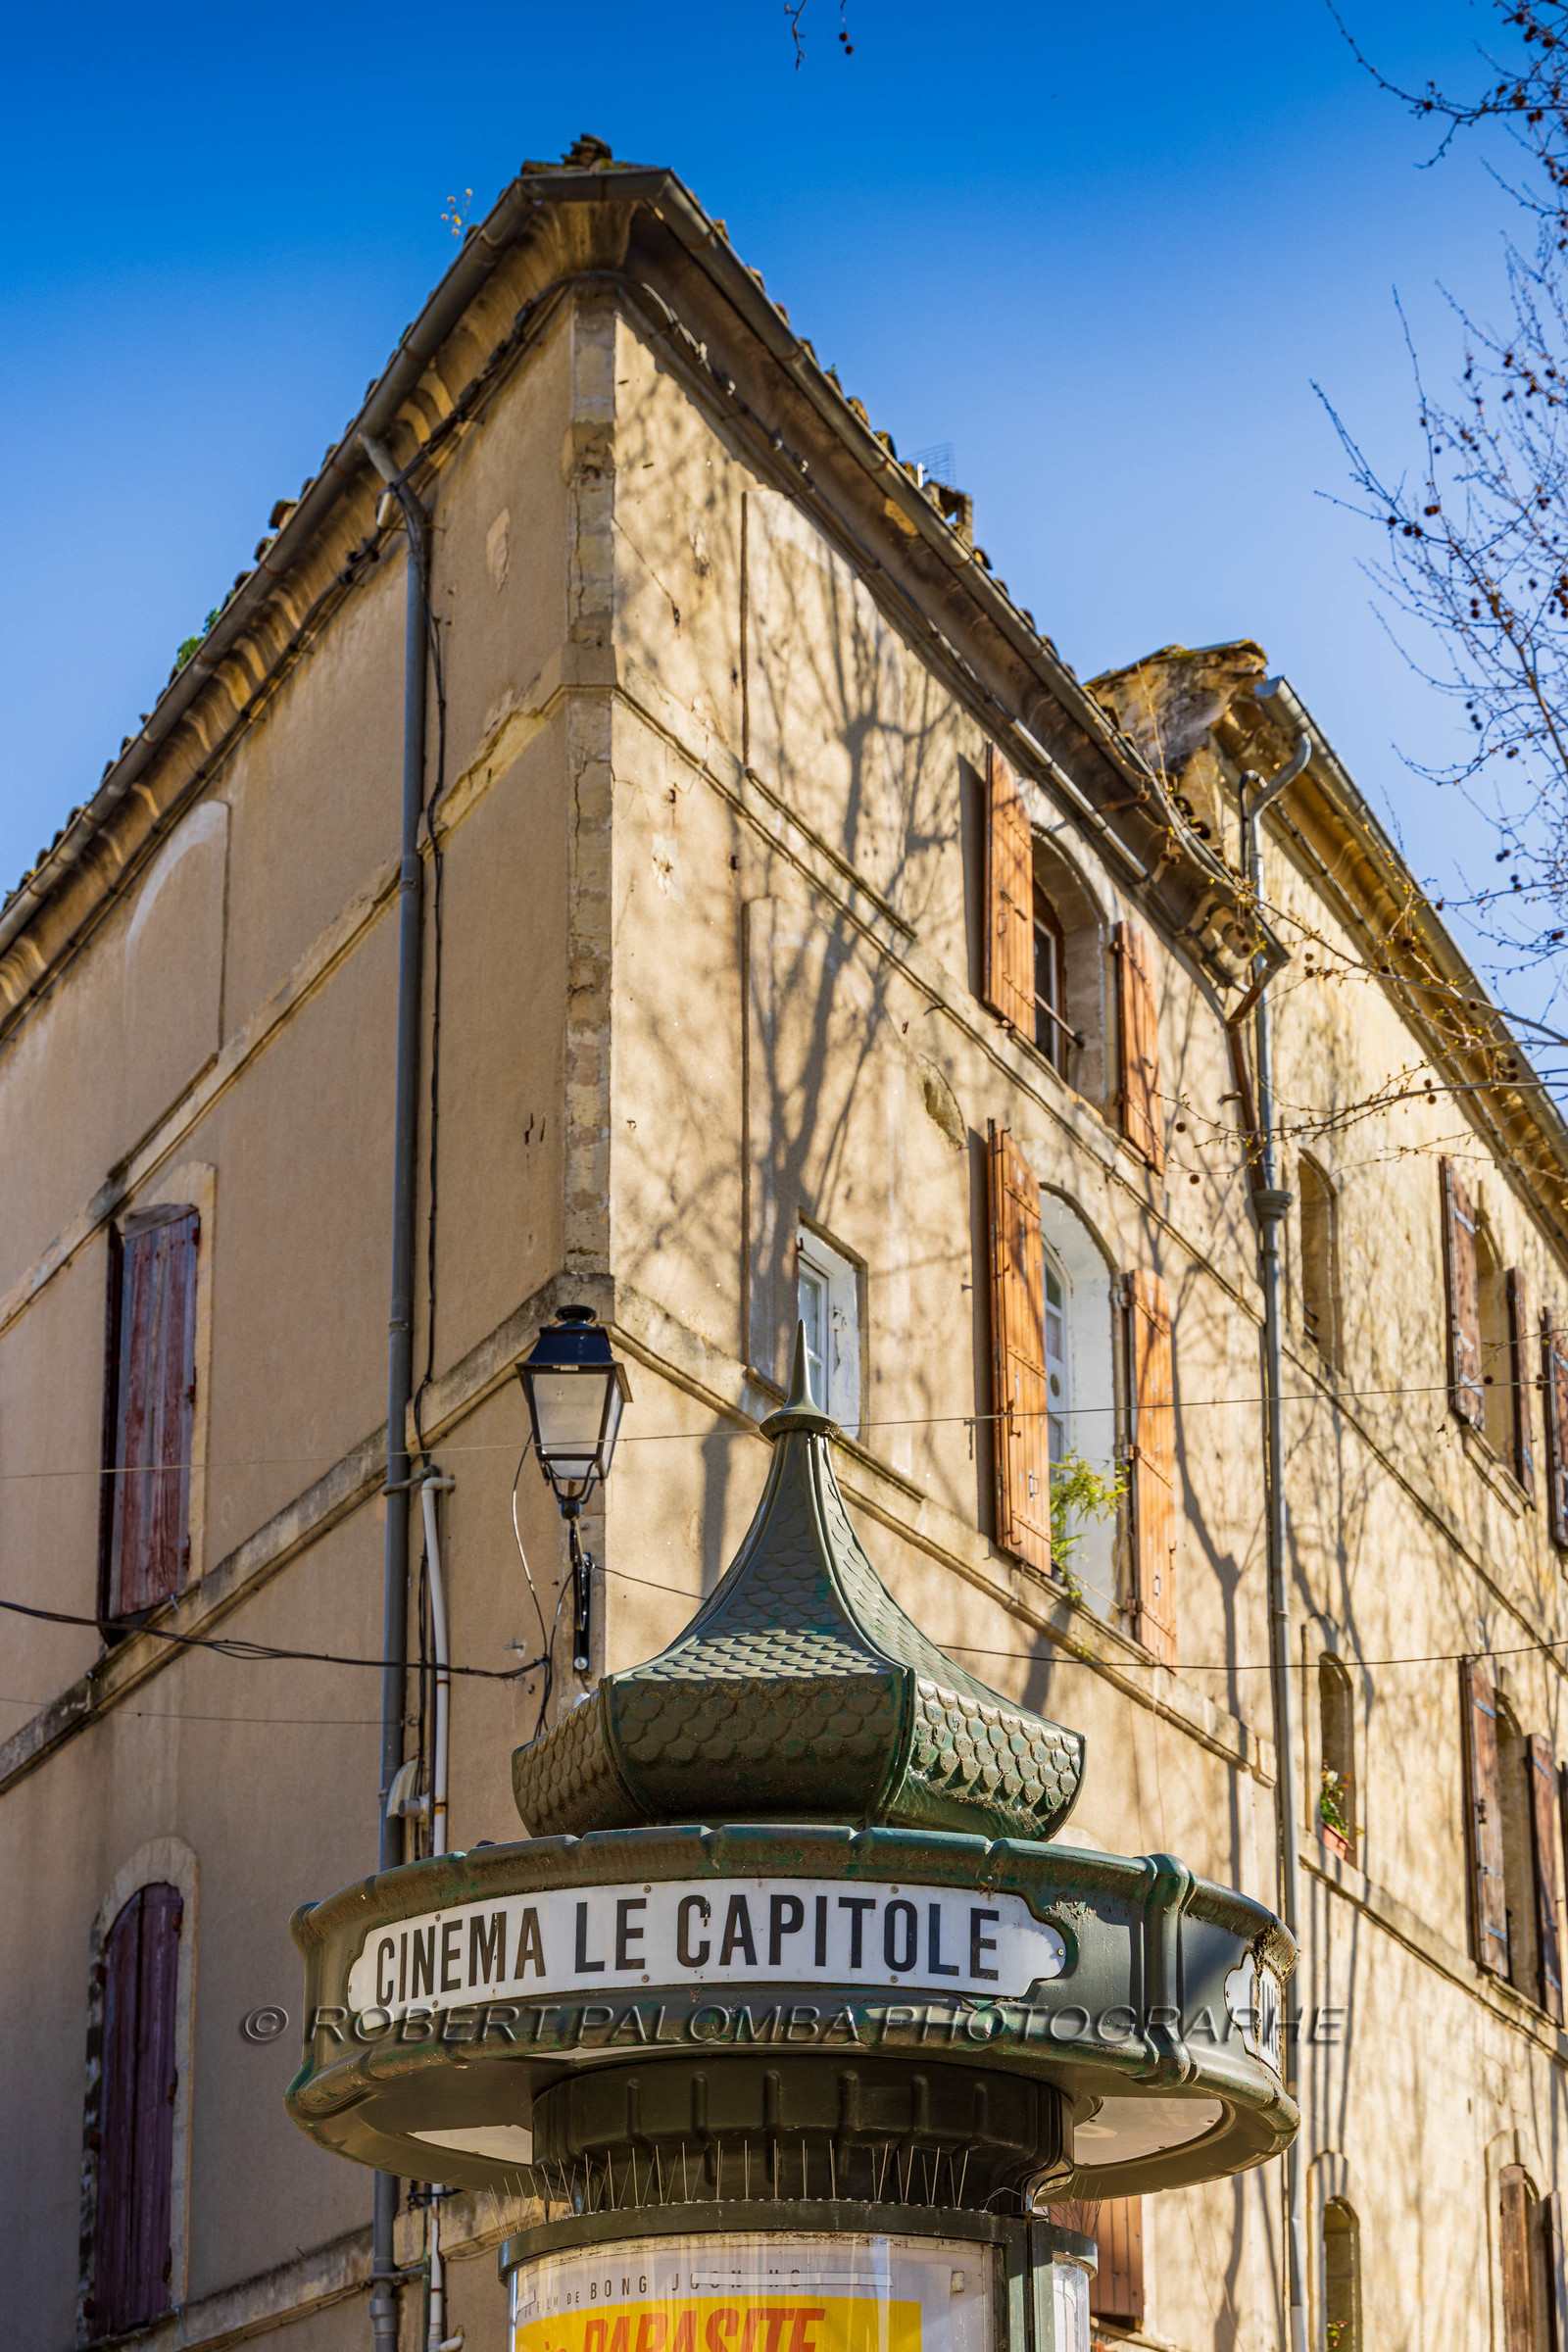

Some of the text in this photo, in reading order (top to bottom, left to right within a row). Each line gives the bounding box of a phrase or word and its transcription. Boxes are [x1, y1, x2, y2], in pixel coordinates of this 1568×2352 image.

[374, 1893, 1000, 2008] CINEMA LE CAPITOLE
[566, 2290, 581, 2305] DE
[590, 2275, 648, 2300] BONG
